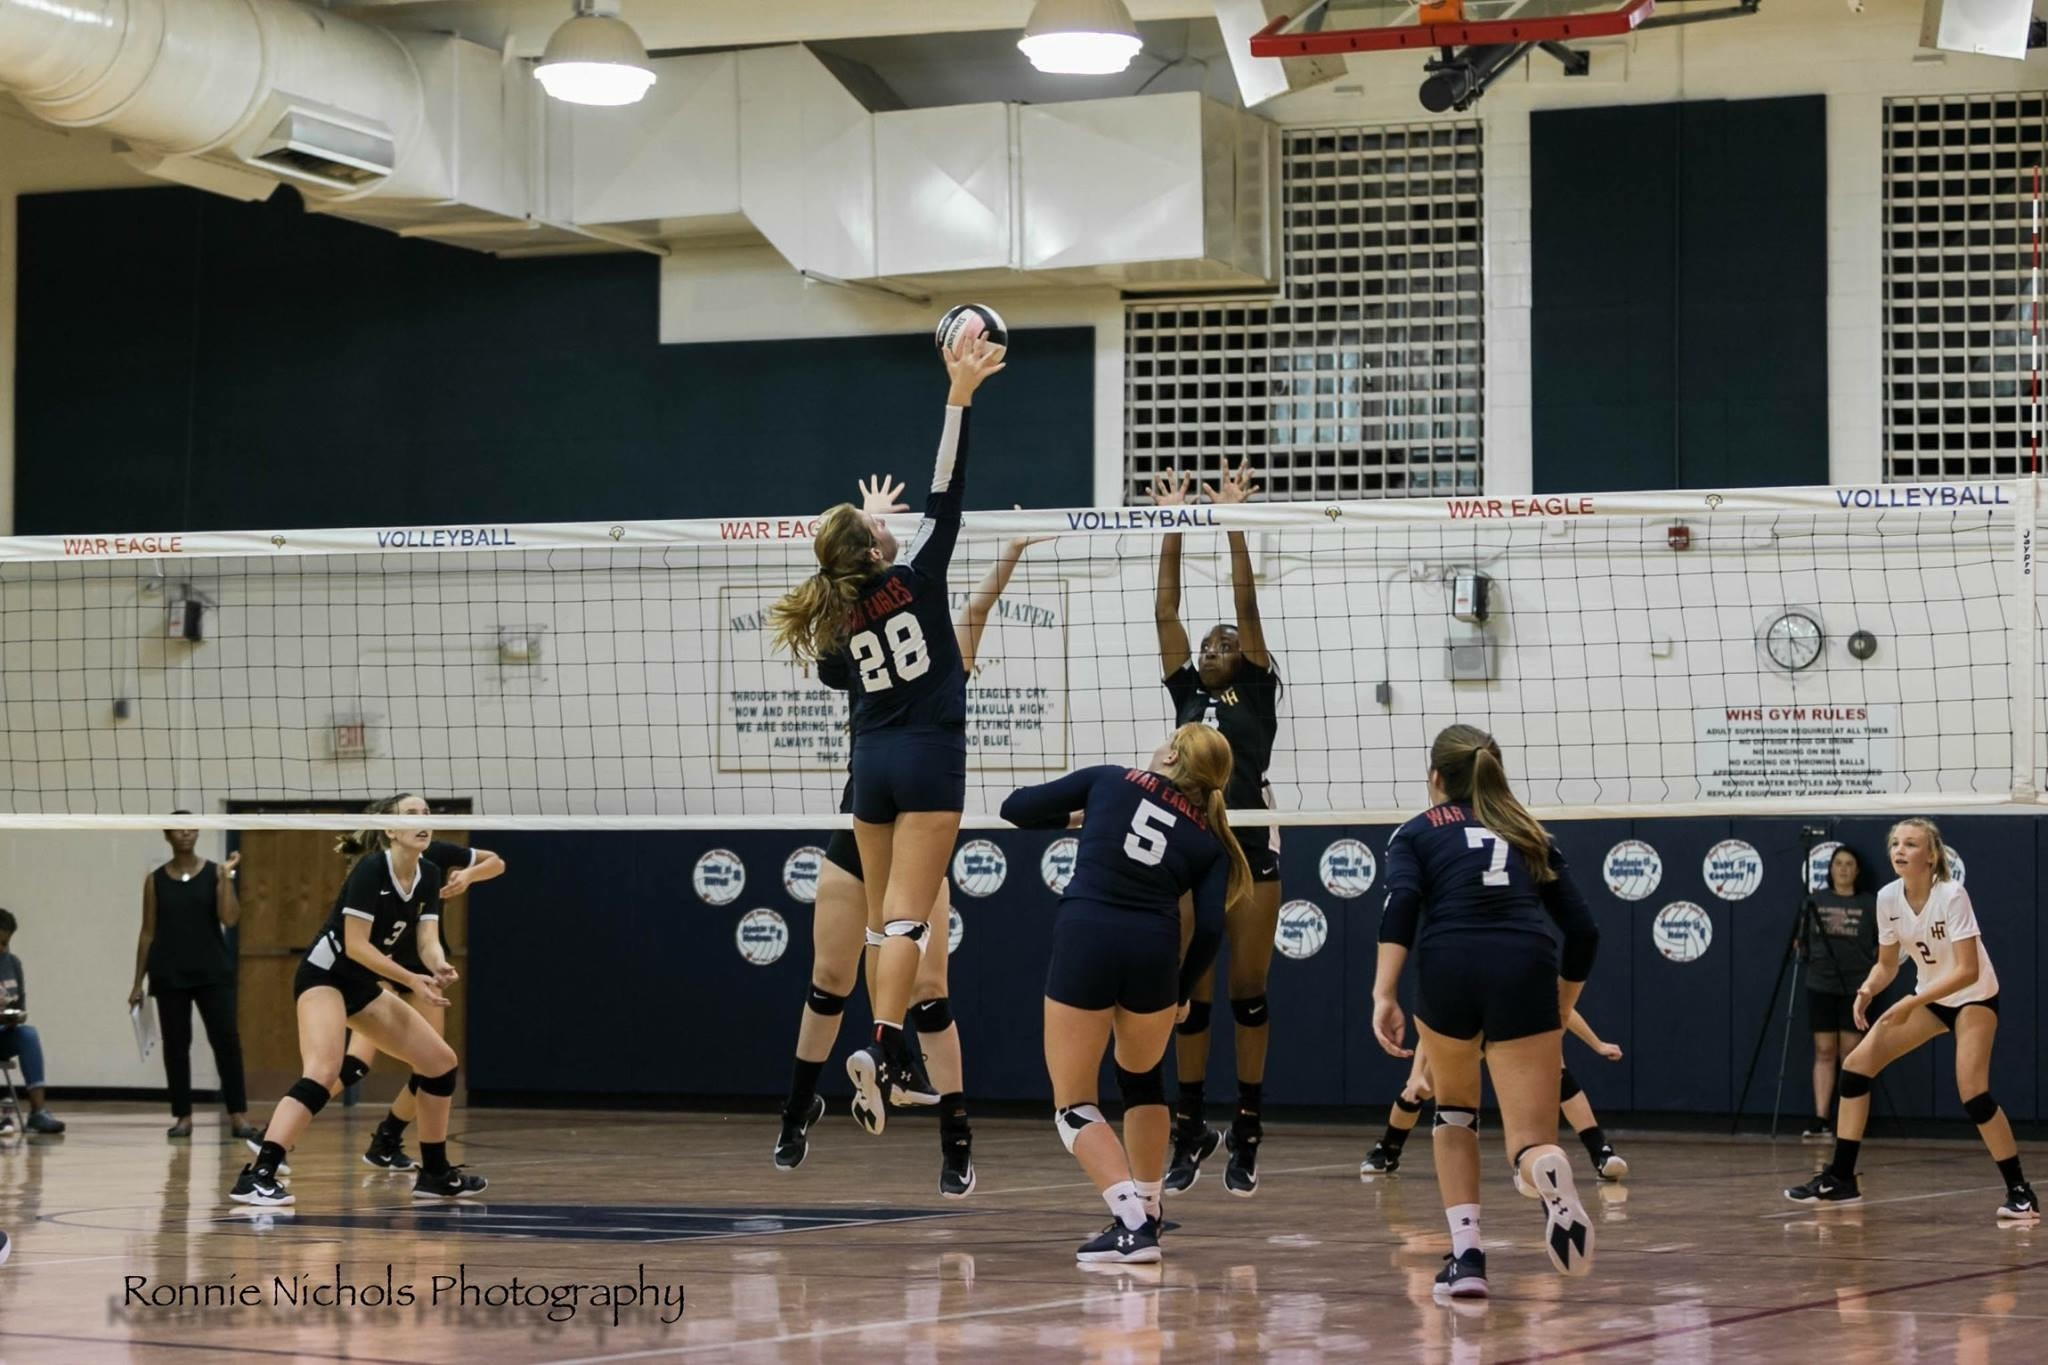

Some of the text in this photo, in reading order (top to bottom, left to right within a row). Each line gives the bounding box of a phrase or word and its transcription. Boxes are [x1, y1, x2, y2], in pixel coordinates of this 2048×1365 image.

[1837, 485, 2009, 508] VOLLEYBALL
[1067, 508, 1221, 530] VOLLEYBALL
[1448, 497, 1596, 520] WAR EAGLE
[377, 528, 517, 548] VOLLEYBALL
[720, 520, 821, 540] WAR EAG
[63, 536, 183, 556] WAR EAGLE
[2023, 529, 2031, 575] Jaypro
[996, 598, 1056, 629] MATER
[850, 611, 932, 693] 28
[732, 690, 777, 702] THROUGH
[782, 690, 801, 701] THE
[763, 706, 783, 717] AND
[966, 703, 1014, 715] WAKULLA
[1726, 708, 1867, 720] WHS GYM RULES
[736, 721, 752, 733] WE
[756, 721, 776, 732] ARE
[976, 719, 1010, 730] FLYING
[774, 736, 844, 748] ALWAYS TRUE
[817, 752, 839, 763] THIS
[1124, 769, 1160, 793] WAR
[1425, 805, 1466, 828] WAR
[1123, 798, 1177, 867] 5
[1464, 827, 1510, 886] 7
[384, 921, 407, 946] 3
[1916, 941, 1936, 964] 2
